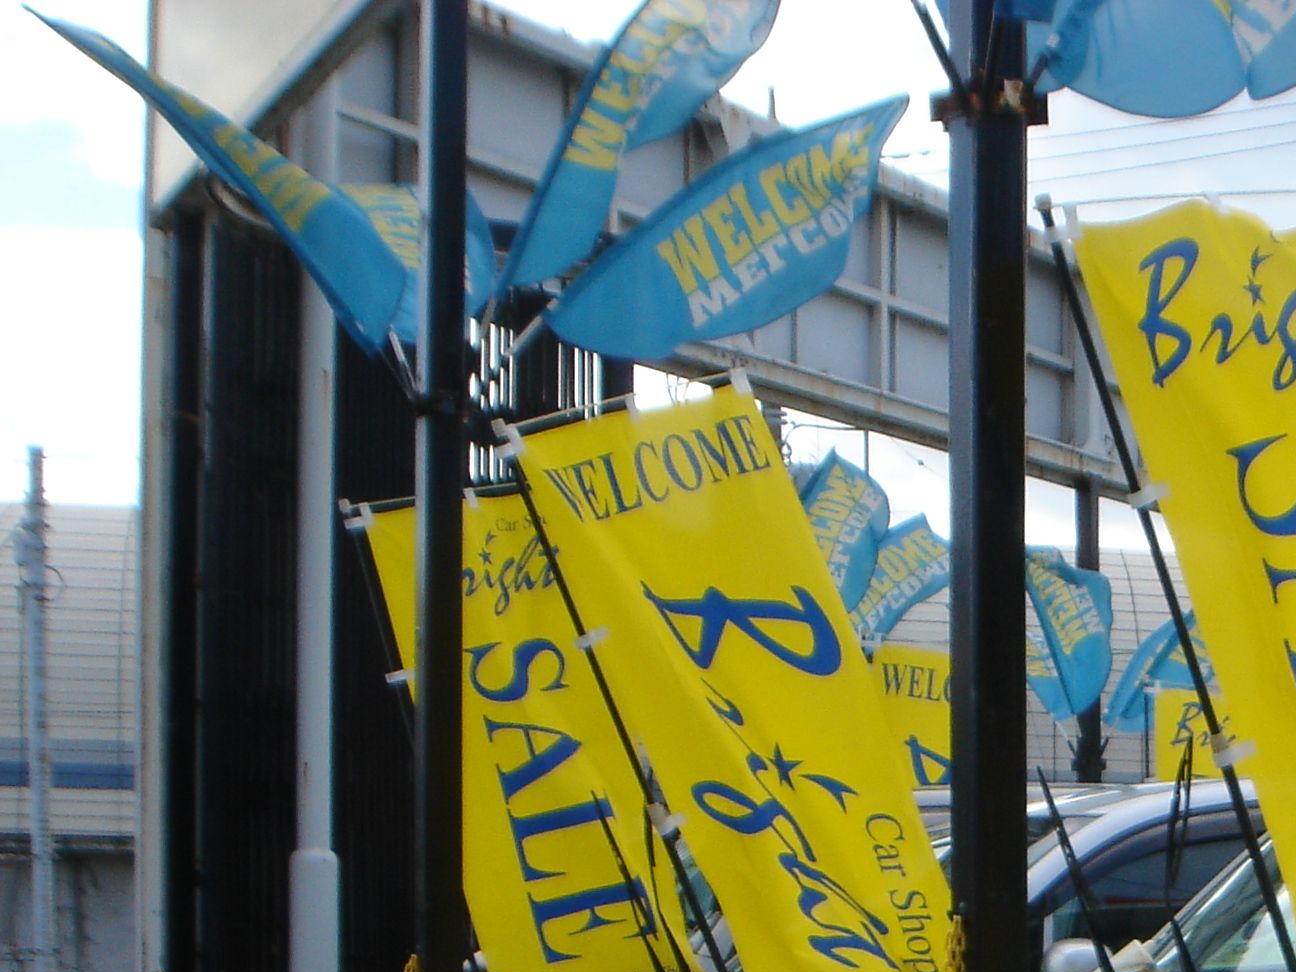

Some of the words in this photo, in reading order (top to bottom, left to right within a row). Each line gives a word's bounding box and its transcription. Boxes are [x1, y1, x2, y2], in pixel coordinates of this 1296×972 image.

[656, 122, 877, 296] WELCOME
[542, 414, 771, 523] WELCOME
[462, 533, 560, 617] right
[463, 637, 657, 964] SALE
[865, 813, 907, 878] Car
